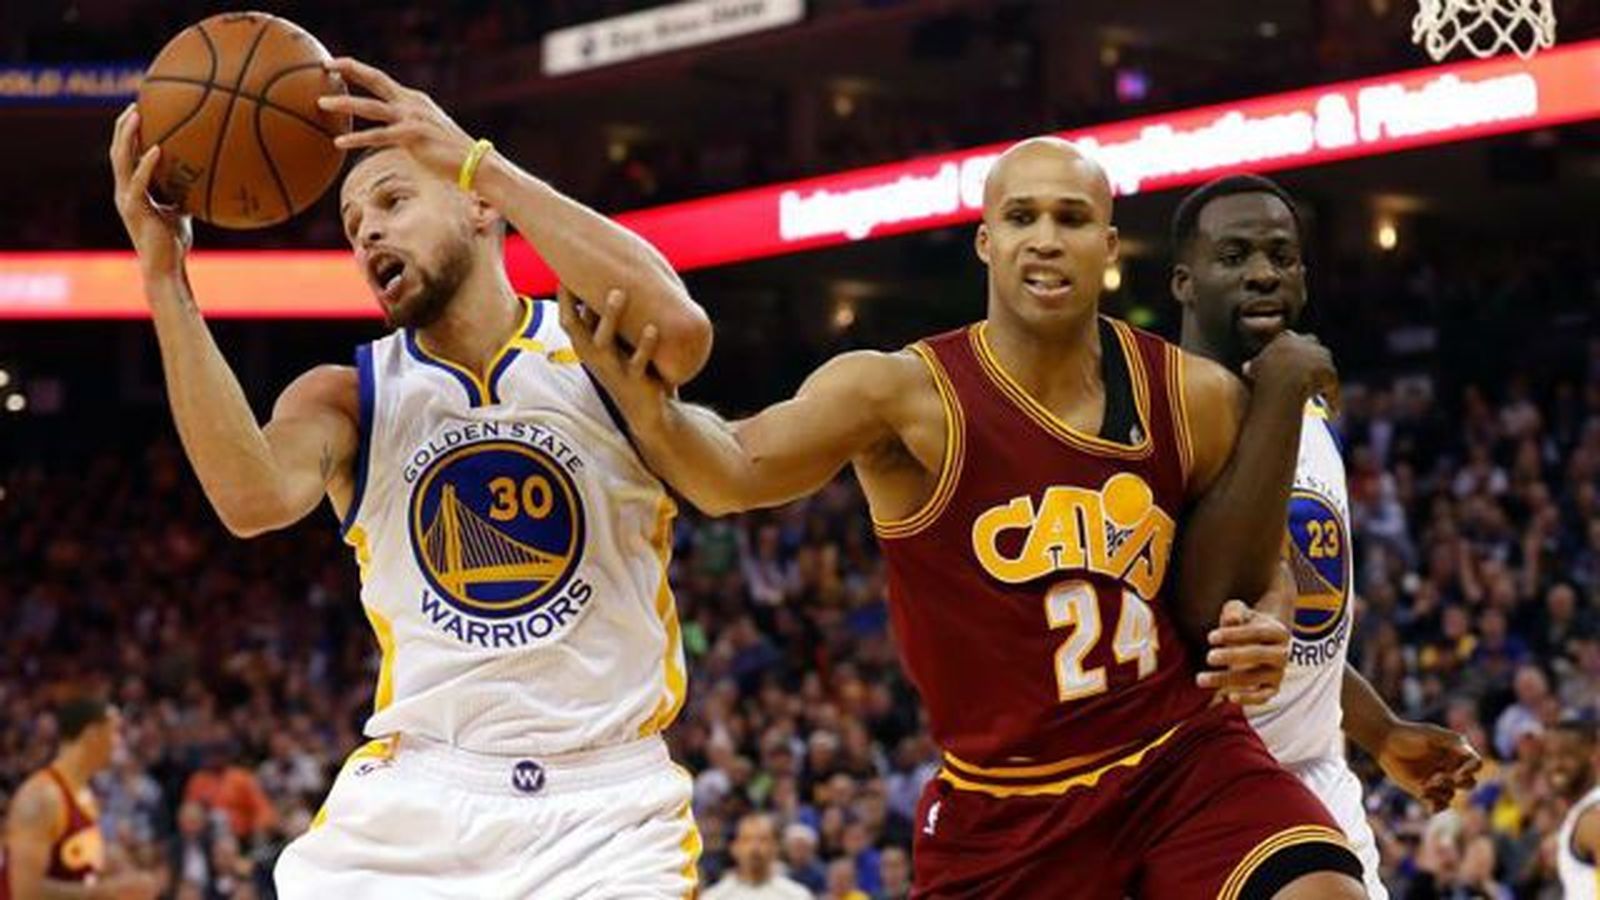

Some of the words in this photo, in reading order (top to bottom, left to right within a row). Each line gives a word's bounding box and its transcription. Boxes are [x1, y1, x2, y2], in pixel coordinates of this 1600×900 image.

[403, 421, 499, 484] GOLDEN
[510, 422, 584, 474] STATE
[488, 474, 554, 522] 30
[1306, 519, 1340, 558] 23
[421, 578, 593, 648] WARRIORS
[1045, 577, 1160, 703] 24
